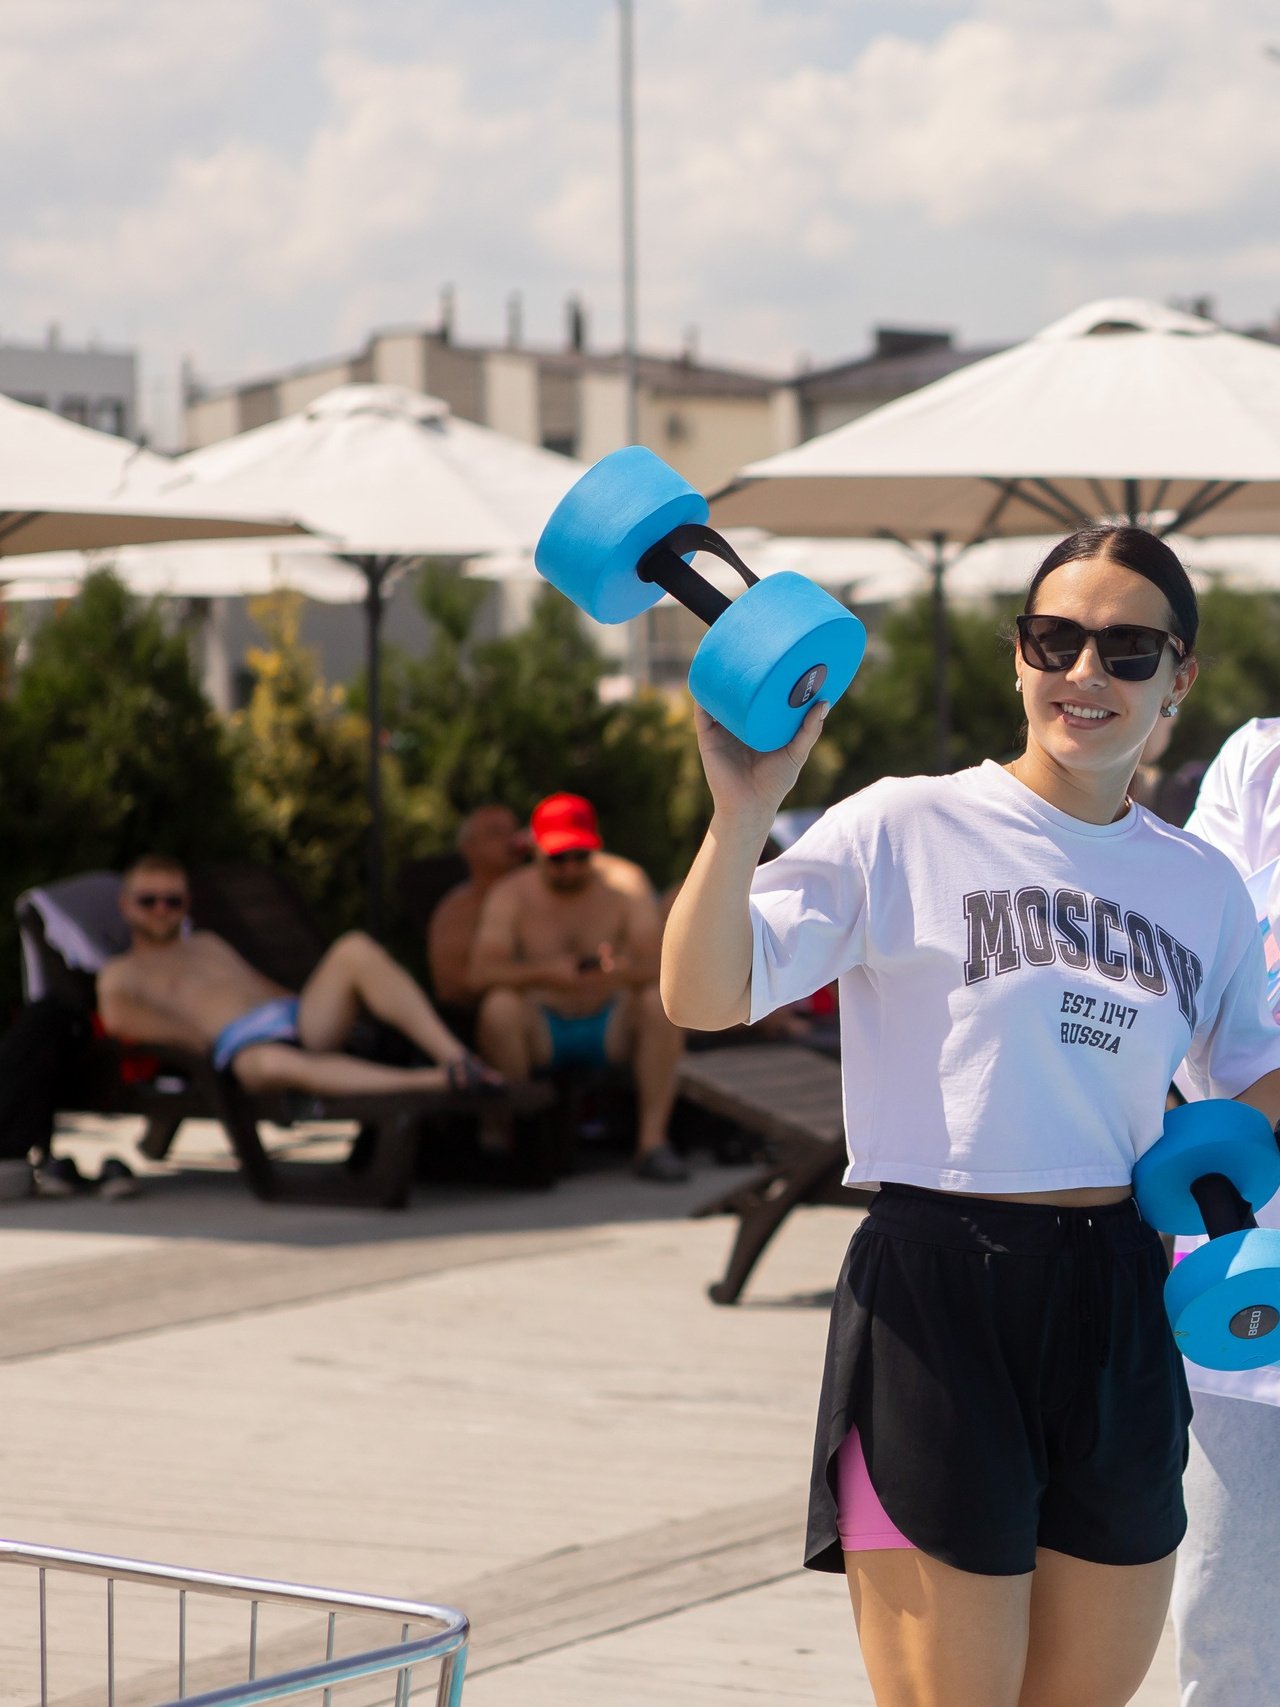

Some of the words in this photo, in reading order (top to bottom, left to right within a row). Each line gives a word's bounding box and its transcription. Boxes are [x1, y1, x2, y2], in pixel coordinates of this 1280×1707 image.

[802, 670, 817, 702] BECO
[962, 886, 1204, 1040] MOSCOW
[1060, 991, 1096, 1020] EST.
[1099, 1001, 1138, 1030] 1147
[1060, 1022, 1122, 1054] RUSSIA
[1248, 1310, 1261, 1336] BECO
